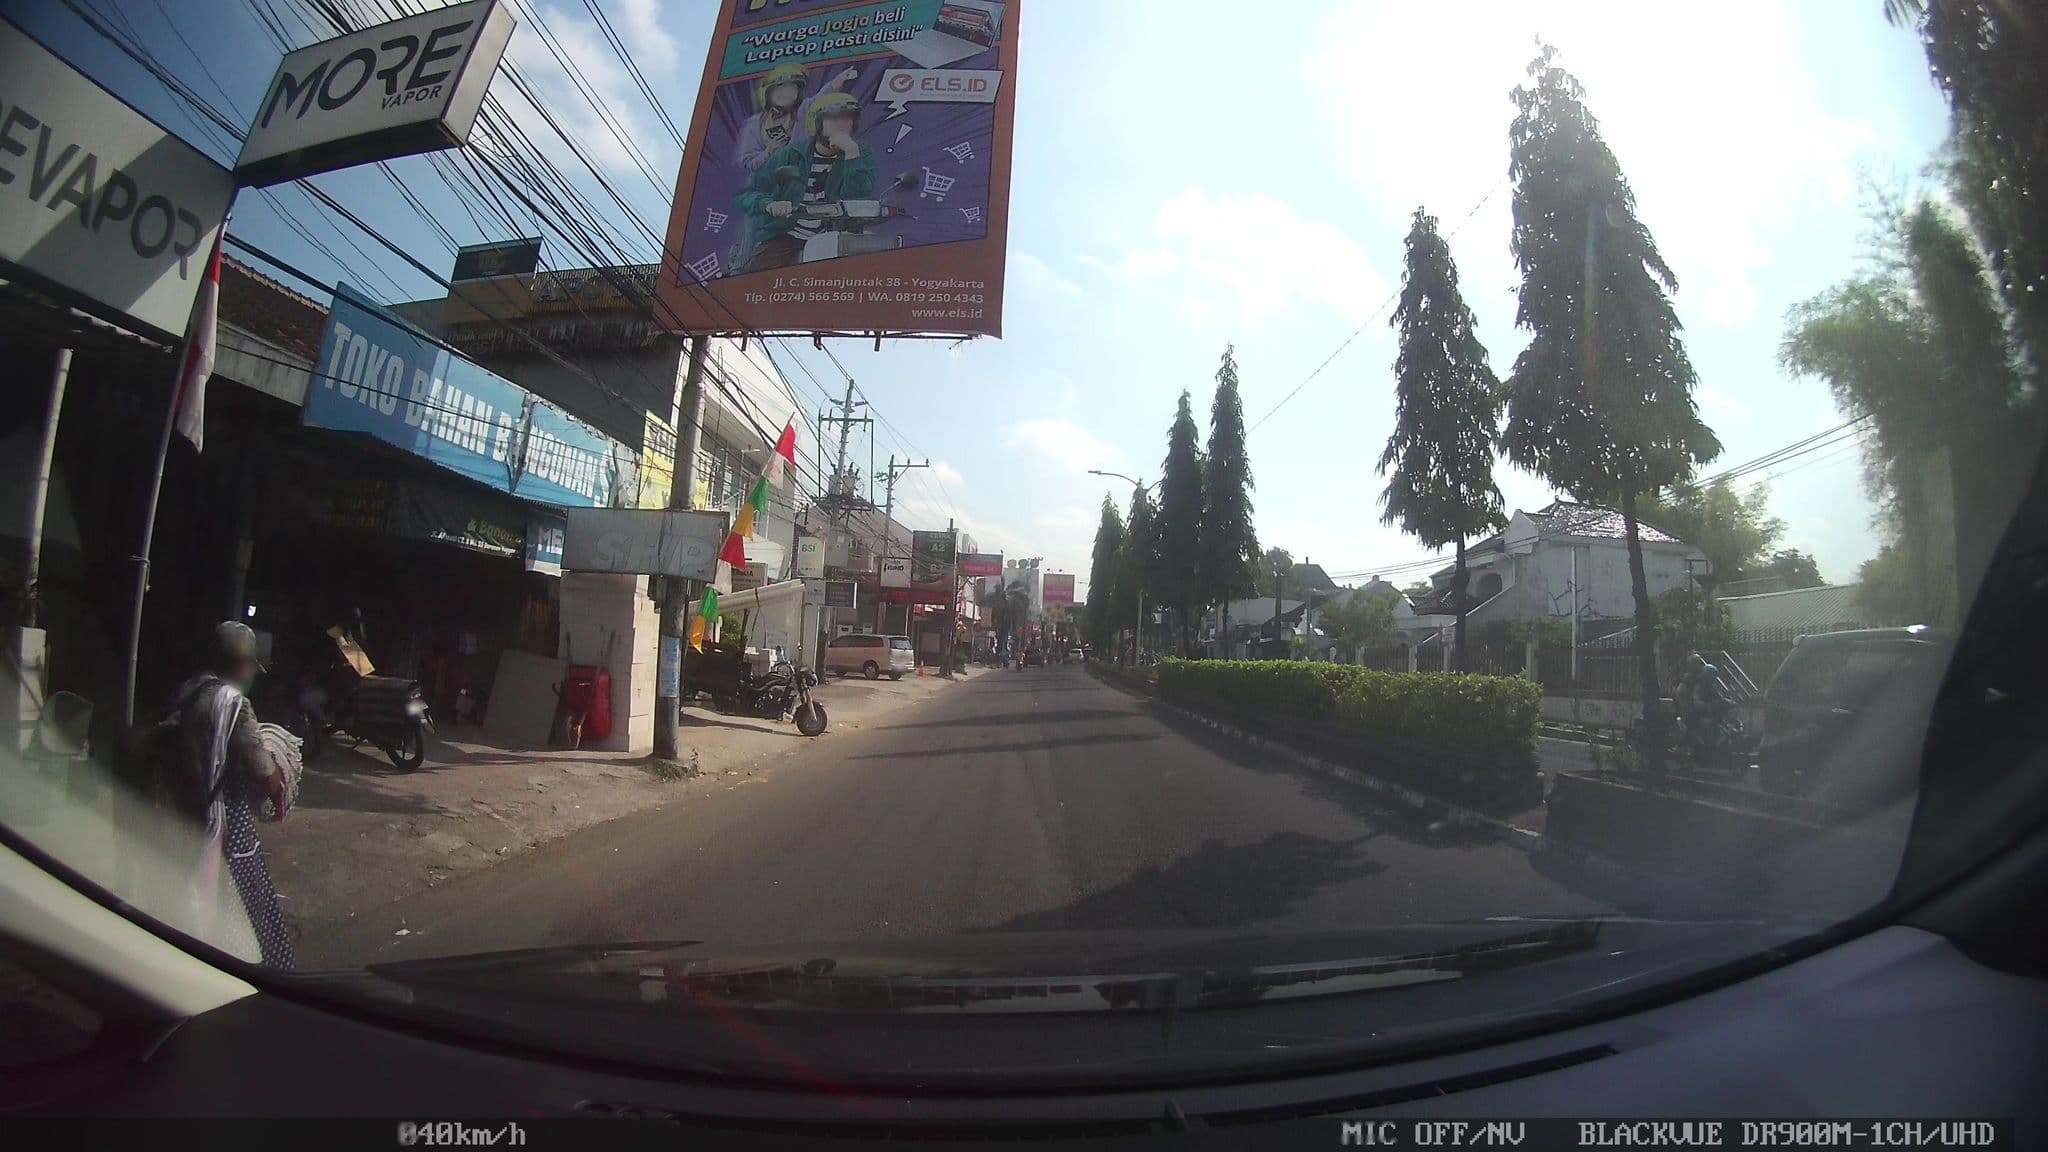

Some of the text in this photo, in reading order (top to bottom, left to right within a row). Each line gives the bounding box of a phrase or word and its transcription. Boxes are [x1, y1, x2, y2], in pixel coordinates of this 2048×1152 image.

[822, 14, 870, 36] Jogja
[874, 6, 906, 24] beli
[746, 41, 817, 63] Laptop
[822, 31, 868, 52] pasti
[261, 19, 474, 129] MORE
[920, 77, 988, 93] ELS.ID
[381, 85, 443, 110] VAPOR
[0, 97, 203, 281] EVAPOR
[789, 278, 801, 287] C.
[803, 277, 883, 290] Simanjuntak
[885, 277, 901, 288] 38
[911, 278, 985, 290] Yogyakarta
[769, 291, 806, 304] (0274)
[808, 292, 831, 302] 566
[832, 292, 855, 302] 569
[867, 292, 893, 302] WA.
[895, 292, 926, 303] 0819
[927, 293, 951, 303] 250
[953, 294, 985, 304] 4343
[911, 308, 984, 319] www.els.id
[324, 321, 405, 416] TOKO
[404, 368, 494, 456] BAHAN
